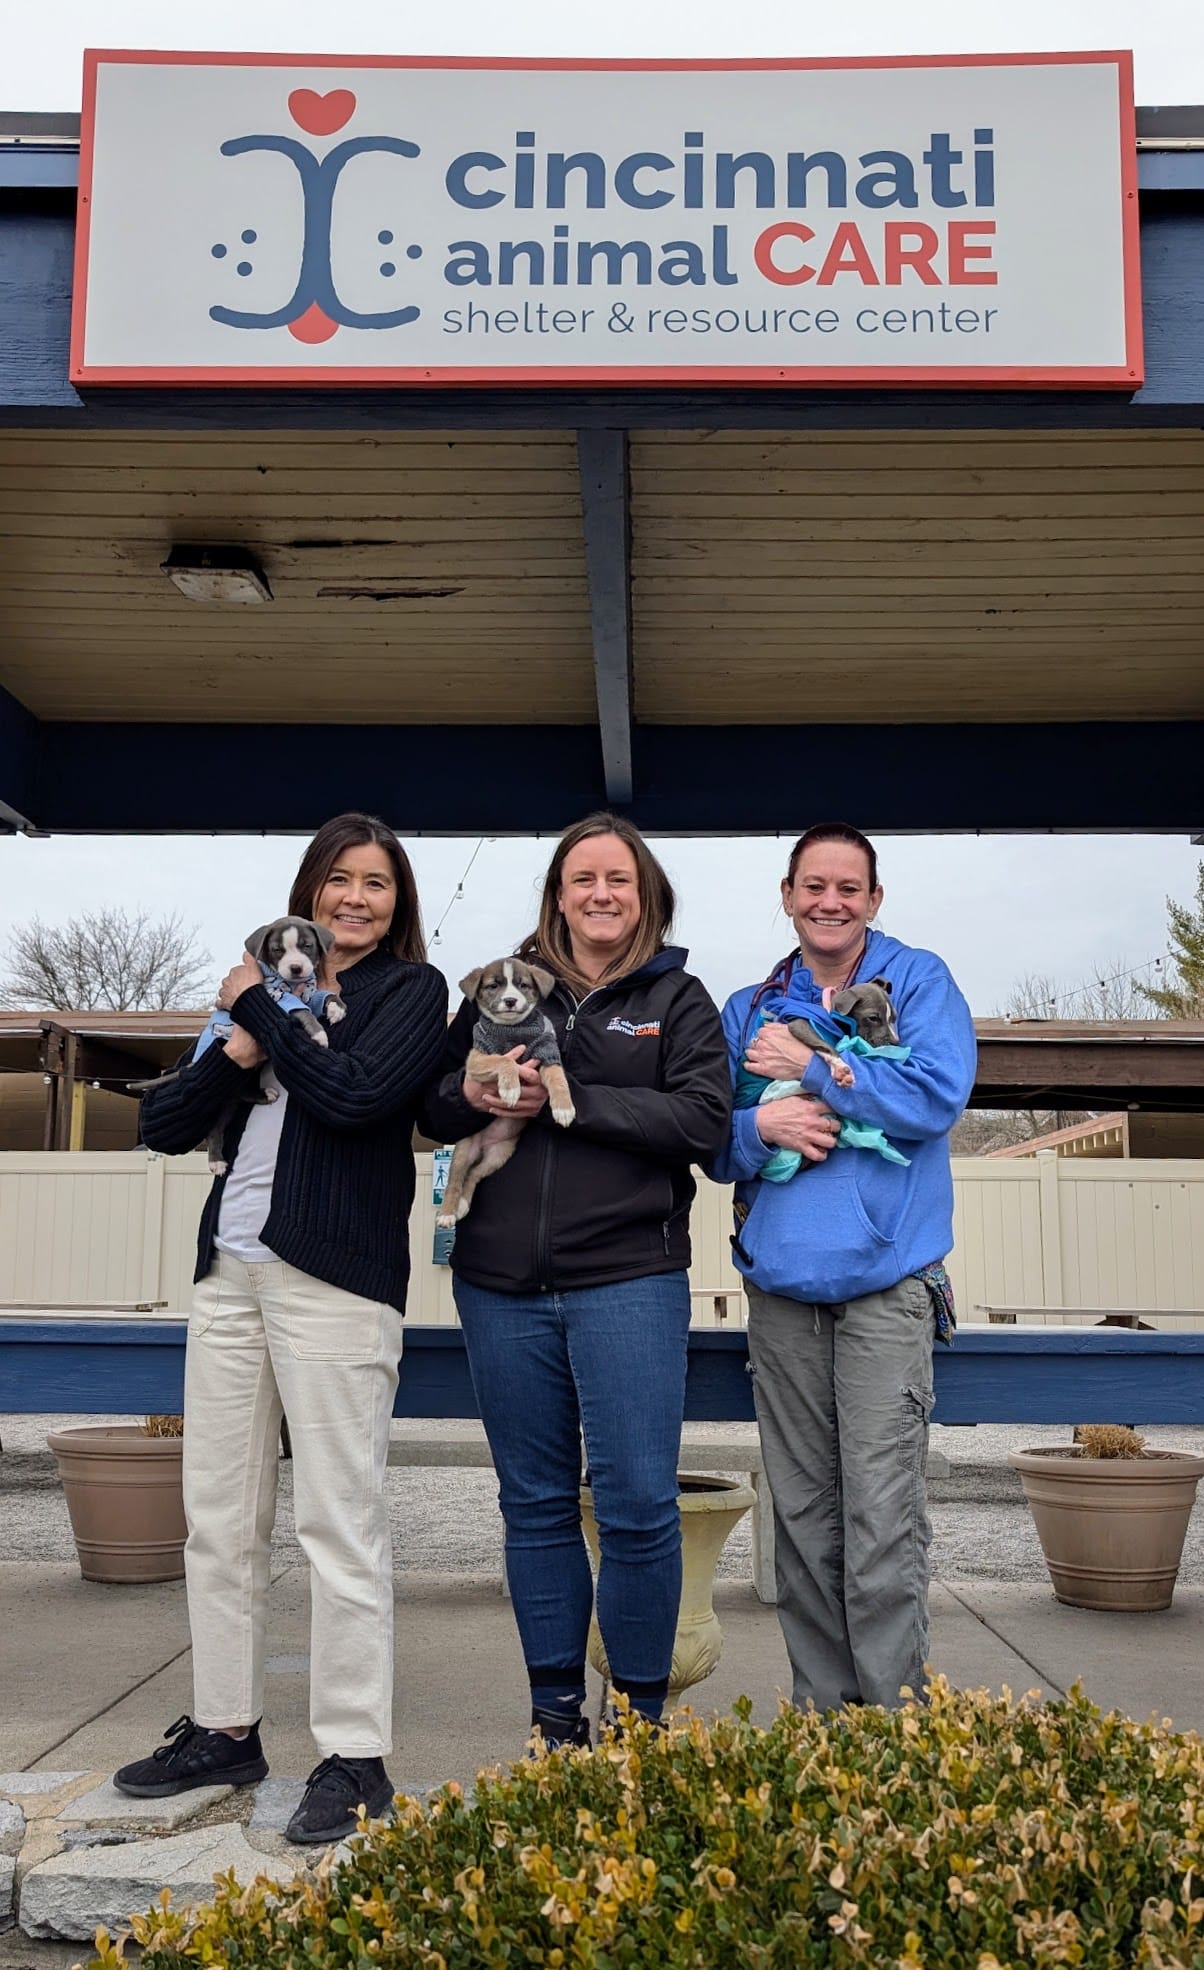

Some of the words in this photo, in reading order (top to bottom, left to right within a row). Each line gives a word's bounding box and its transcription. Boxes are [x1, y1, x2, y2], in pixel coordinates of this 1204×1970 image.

[446, 128, 994, 209] cincinnati
[443, 224, 738, 286] animal
[753, 221, 998, 286] CARE
[443, 302, 594, 333] shelter
[608, 302, 634, 333] &
[648, 309, 839, 333] resource
[856, 303, 998, 333] center
[607, 1024, 635, 1036] animal
[635, 1028, 660, 1036] CARE
